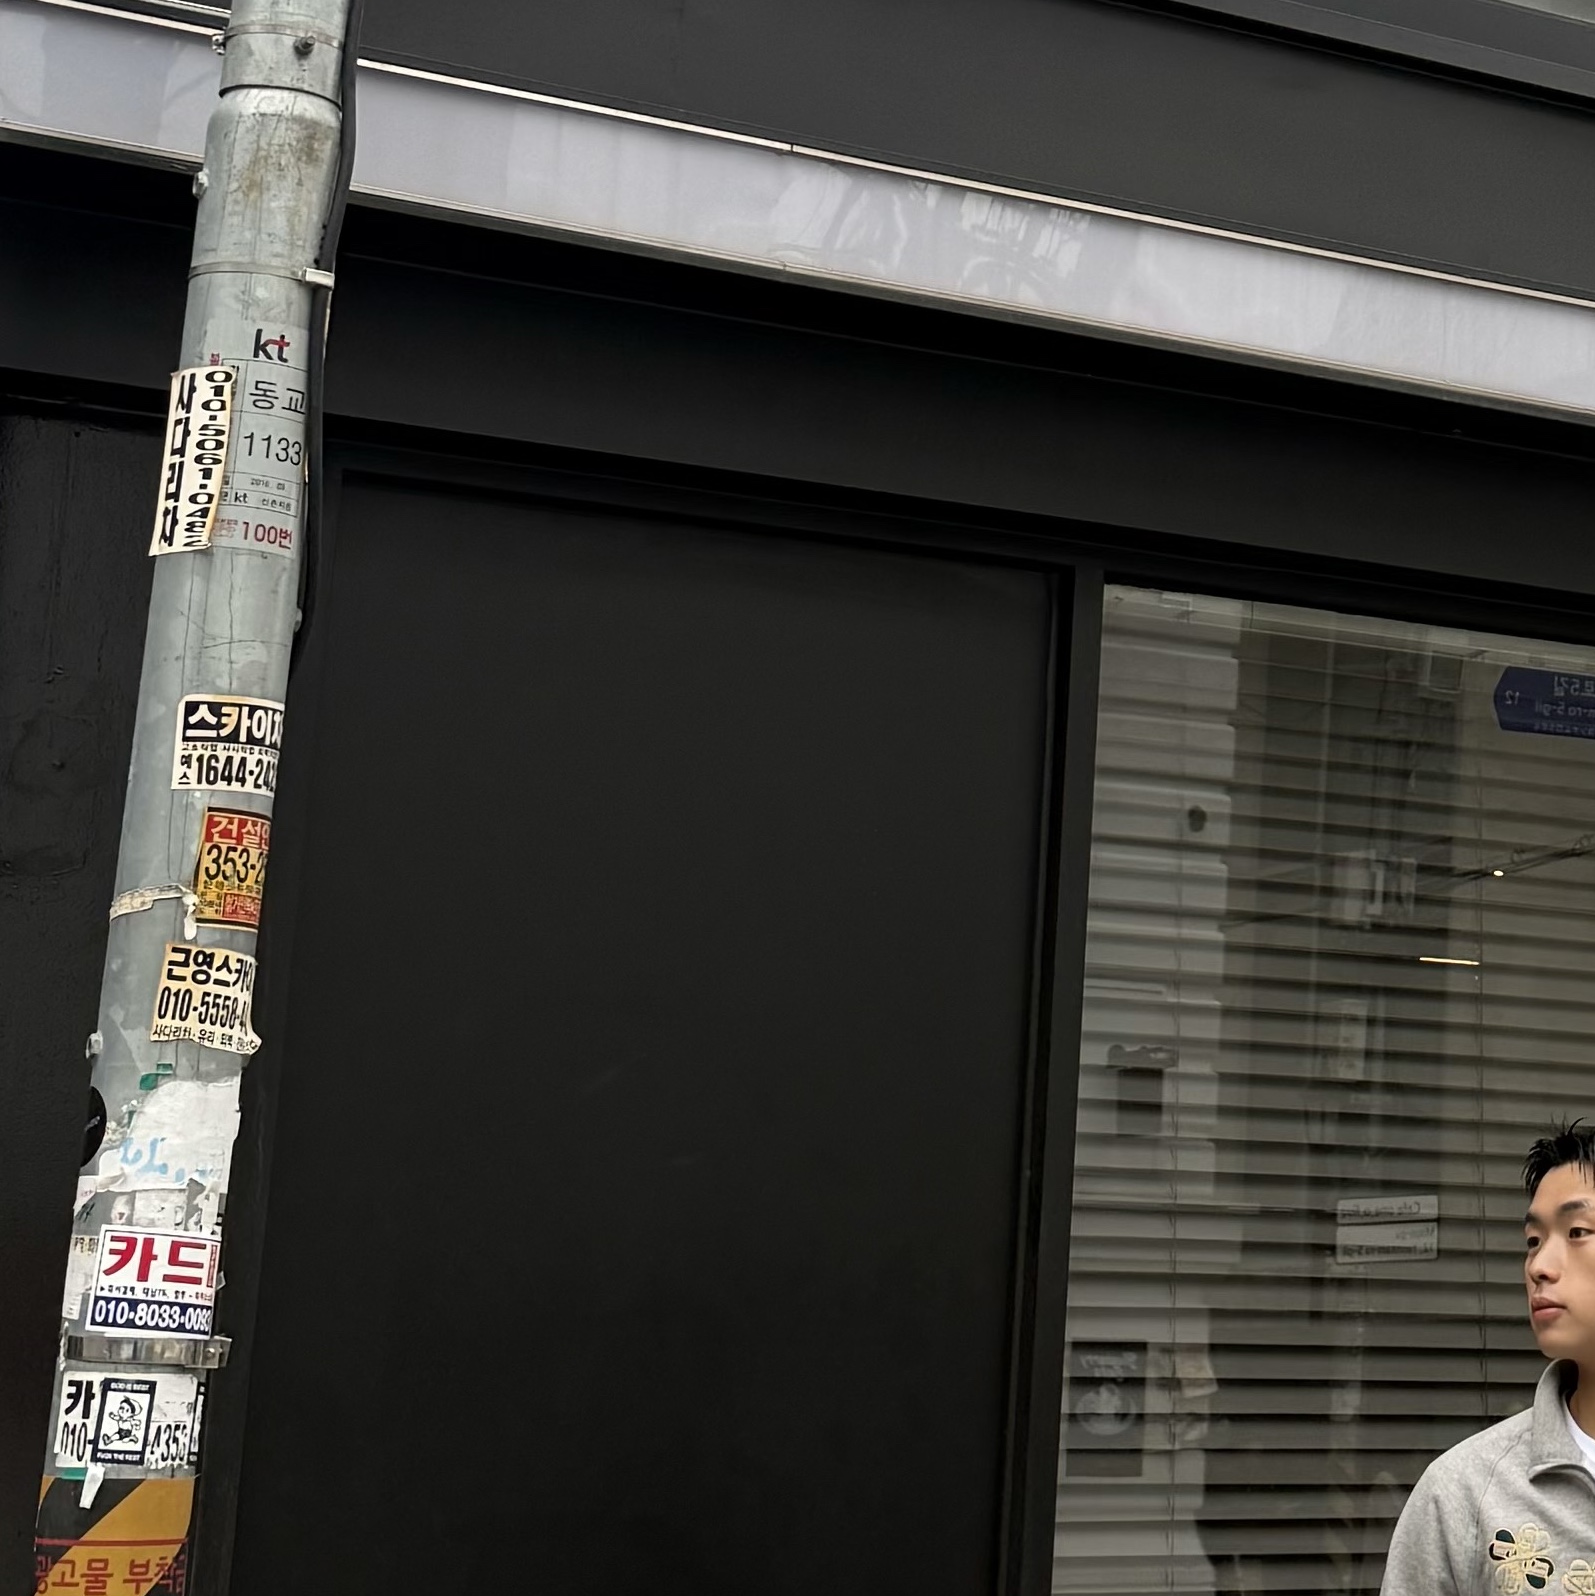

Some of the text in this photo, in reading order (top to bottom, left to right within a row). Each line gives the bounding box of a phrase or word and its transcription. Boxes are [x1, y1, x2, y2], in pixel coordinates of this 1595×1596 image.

[253, 328, 291, 363] kt
[249, 380, 306, 415] 동교
[159, 373, 197, 547] 사다리차
[244, 432, 303, 466] 1133
[243, 521, 293, 550] 100번
[102, 1235, 207, 1285] 카드
[65, 1380, 95, 1419] 카
[35, 1555, 114, 1596] 광고물
